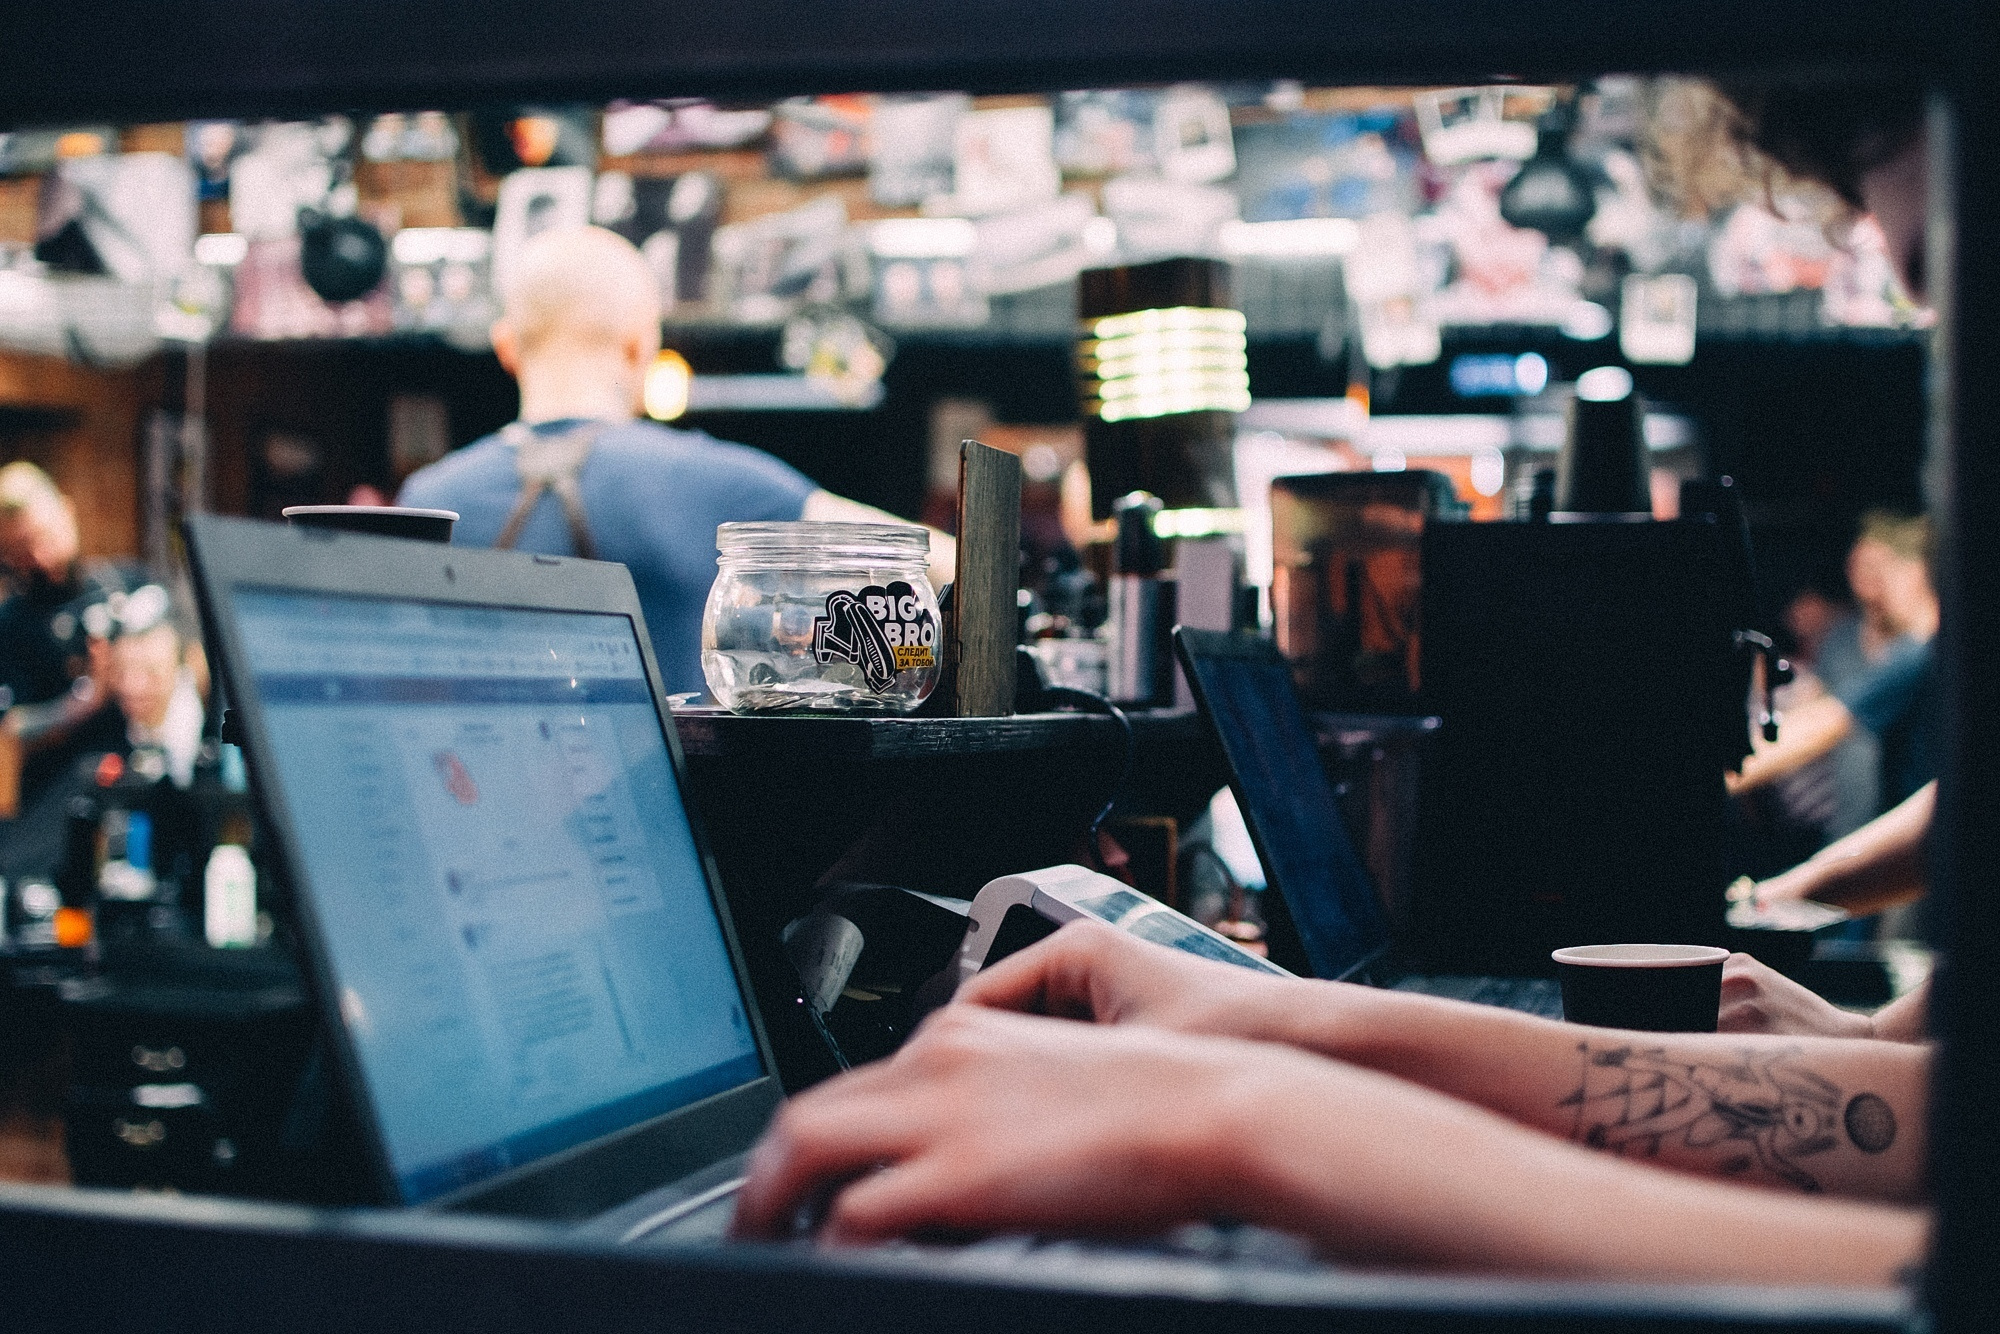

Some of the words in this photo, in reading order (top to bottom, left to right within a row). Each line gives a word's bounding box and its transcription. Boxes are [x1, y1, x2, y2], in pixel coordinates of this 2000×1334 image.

[866, 595, 917, 621] BIG
[884, 622, 934, 647] BRO
[897, 648, 929, 657] СЛЕДИТ
[899, 658, 910, 666] ЗА
[911, 657, 934, 667] ТОБОЙ
